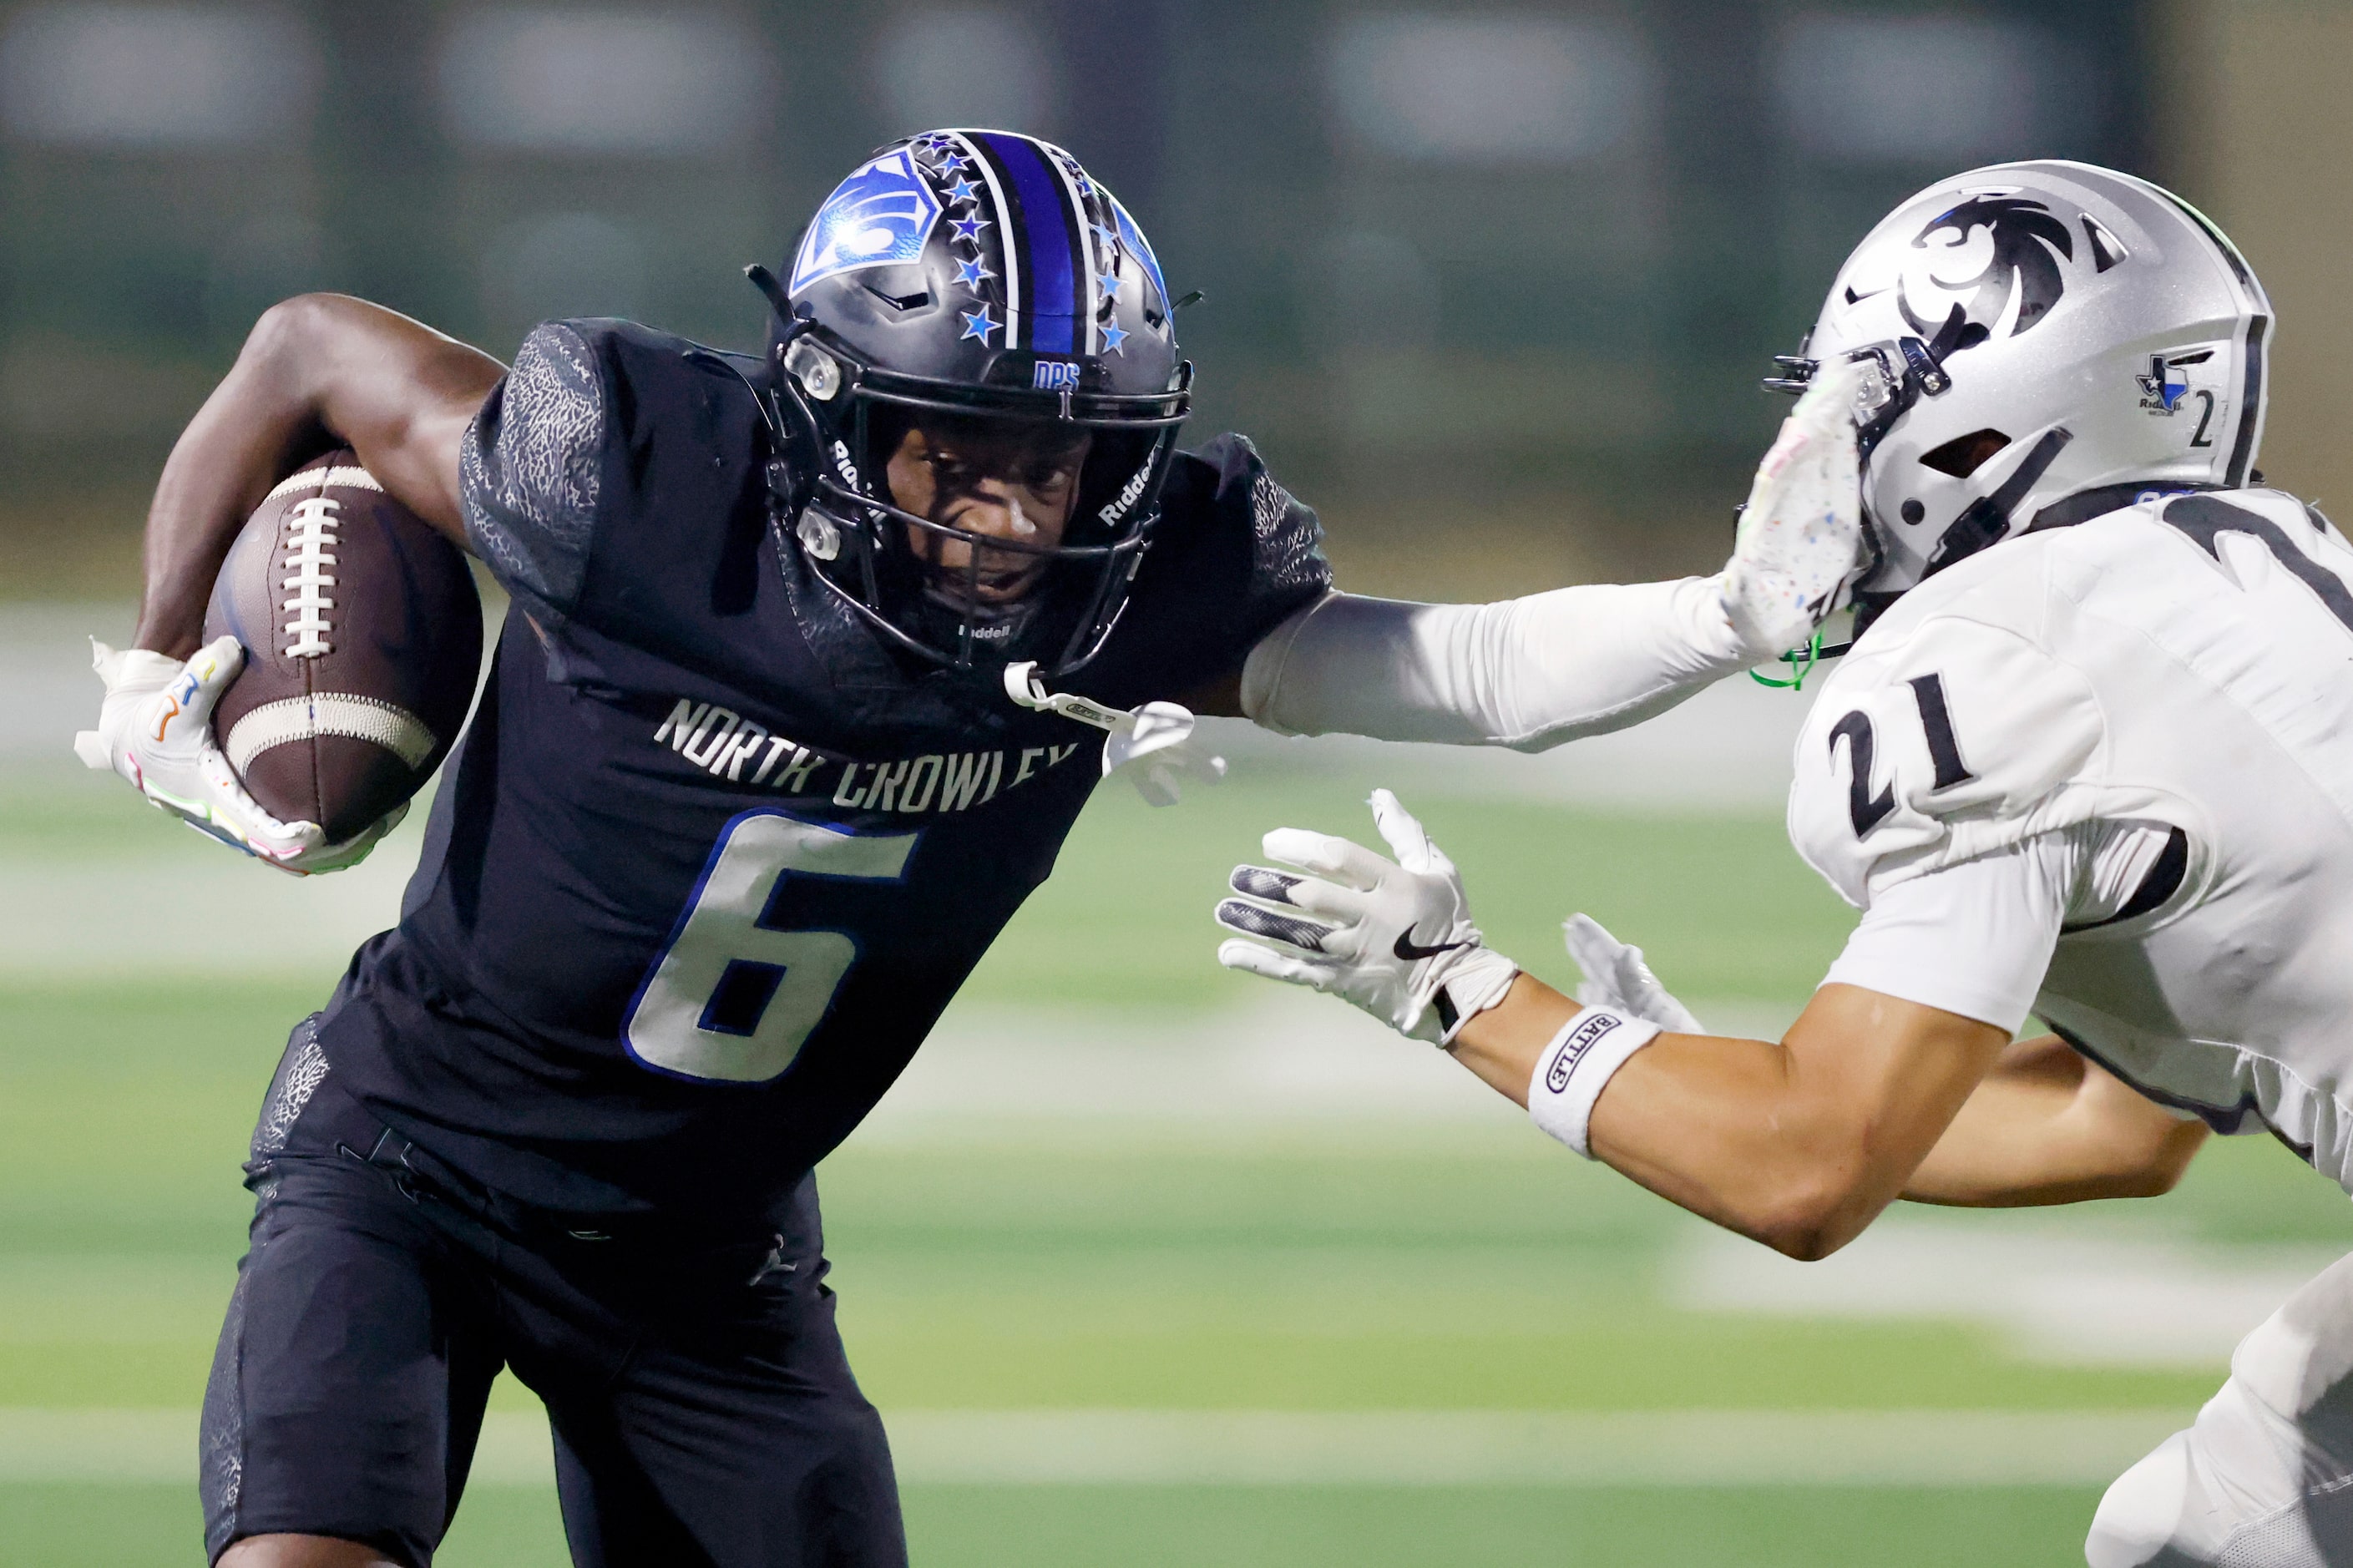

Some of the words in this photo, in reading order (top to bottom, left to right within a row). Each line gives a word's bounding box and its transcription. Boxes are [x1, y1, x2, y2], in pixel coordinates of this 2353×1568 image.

[2189, 389, 2215, 448] 2
[654, 698, 827, 792] NORTH
[833, 742, 1079, 813] CROWLEY
[1828, 670, 1977, 840] 21
[621, 807, 922, 1083] 6
[1551, 1016, 1612, 1085] BATTLE
